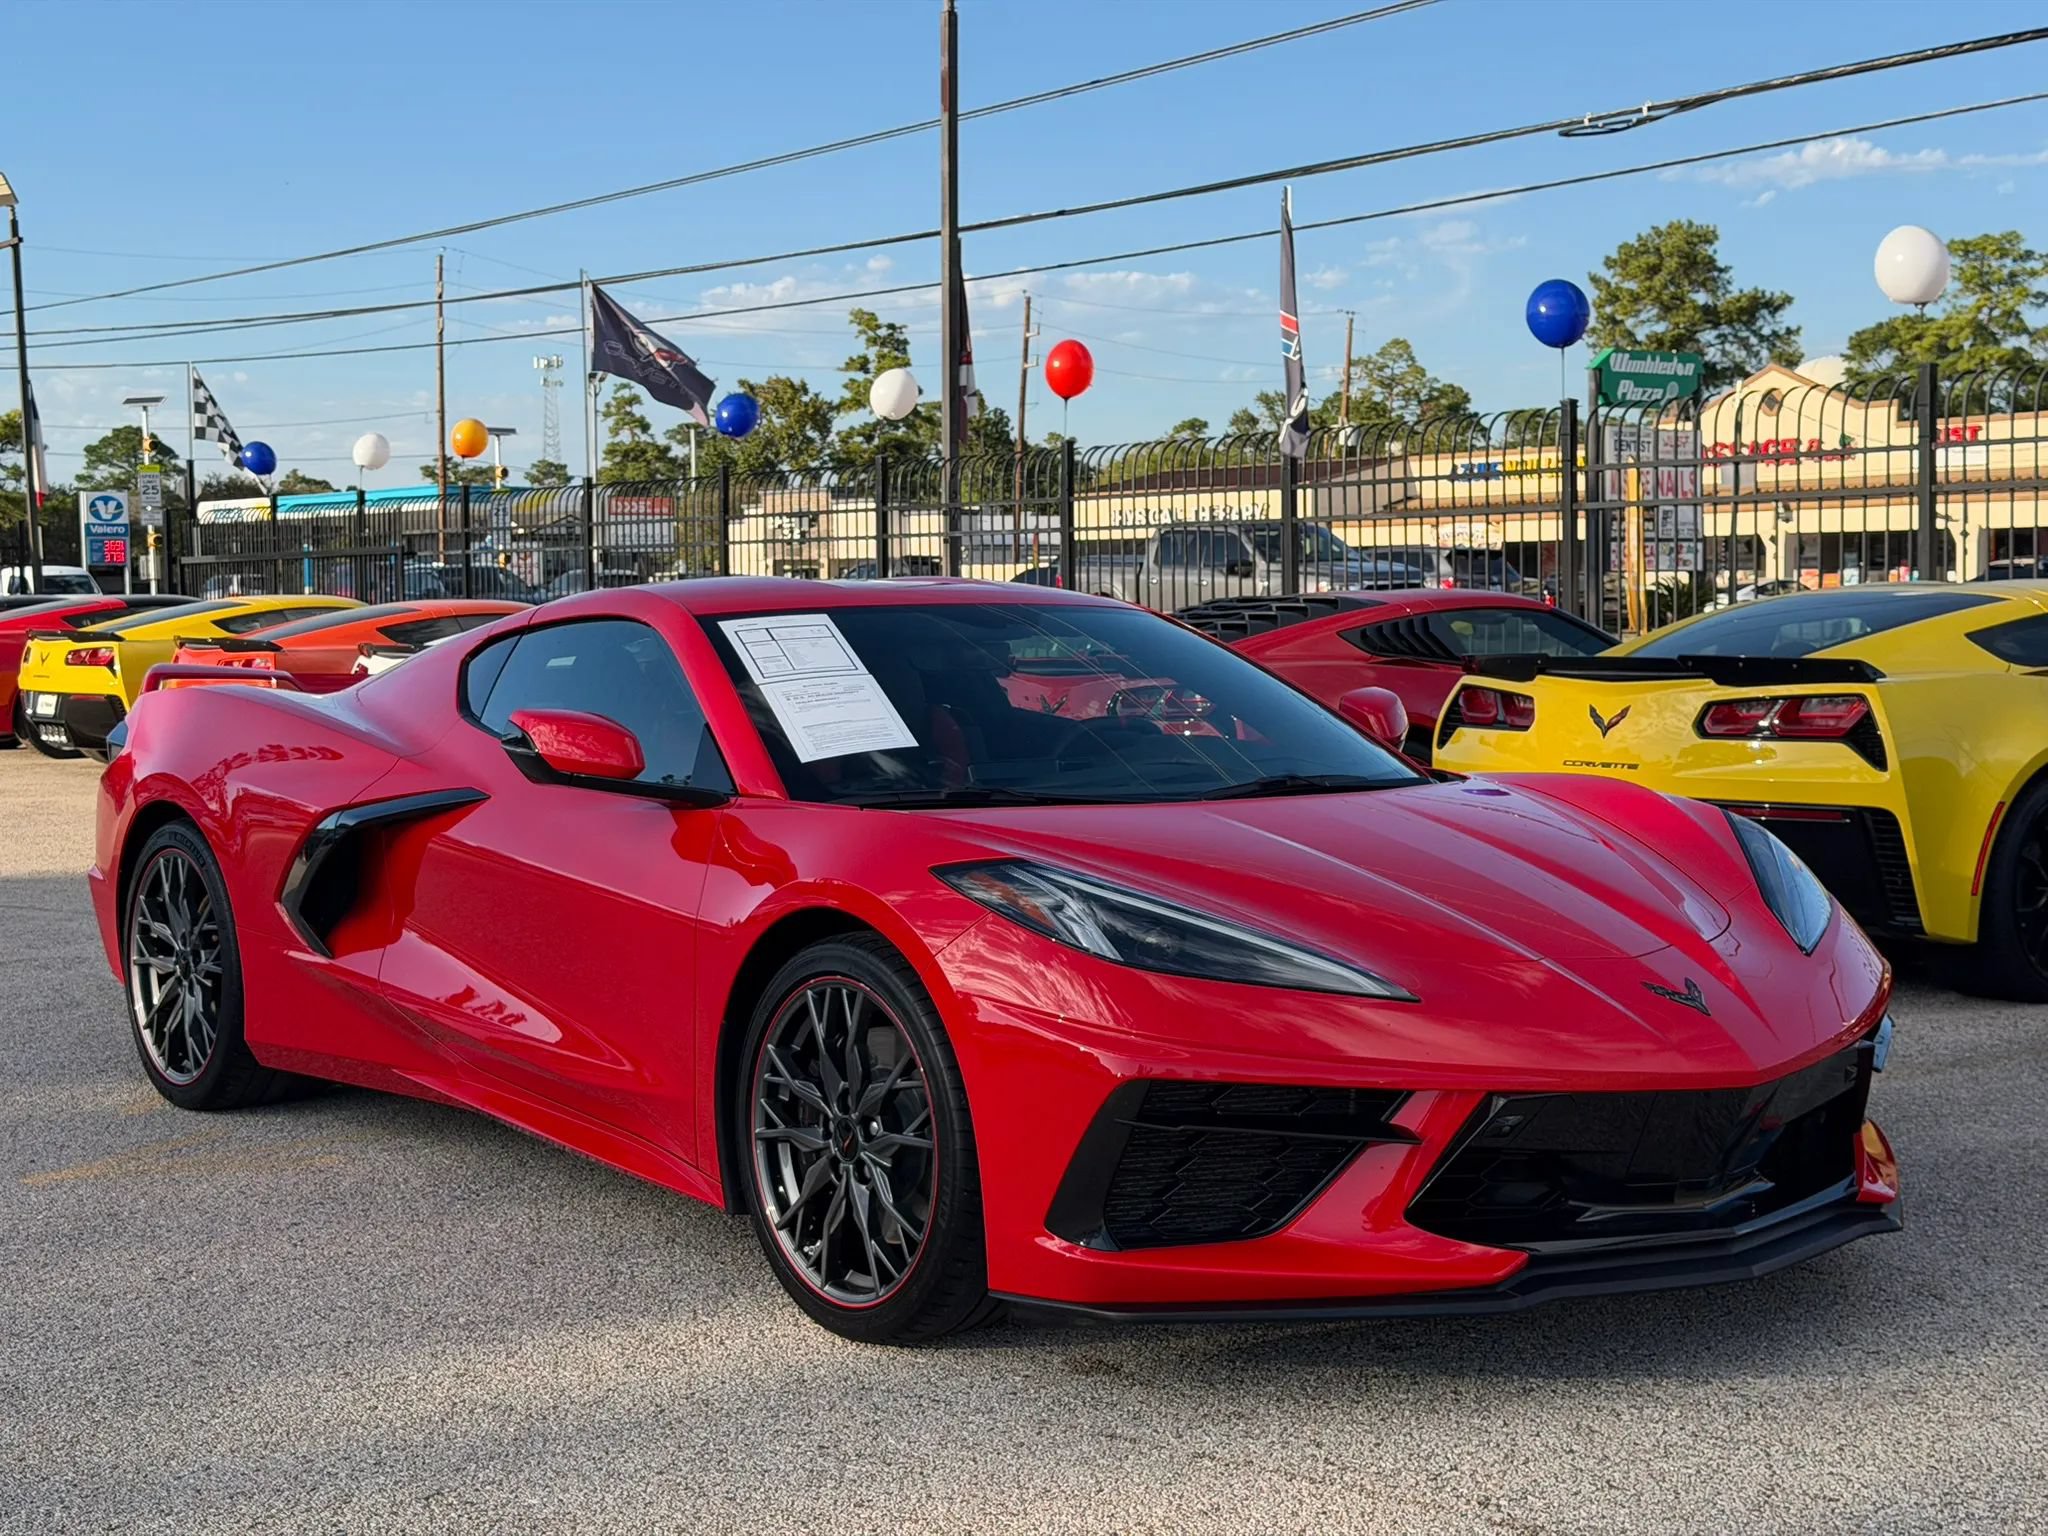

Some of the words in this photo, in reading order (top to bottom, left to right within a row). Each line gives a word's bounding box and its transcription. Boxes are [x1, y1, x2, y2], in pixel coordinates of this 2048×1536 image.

[1609, 352, 1696, 377] Wimbledon
[1617, 379, 1665, 401] Plaza
[142, 485, 159, 496] 25
[89, 525, 126, 534] Valero
[1563, 760, 1639, 770] CORVETTE
